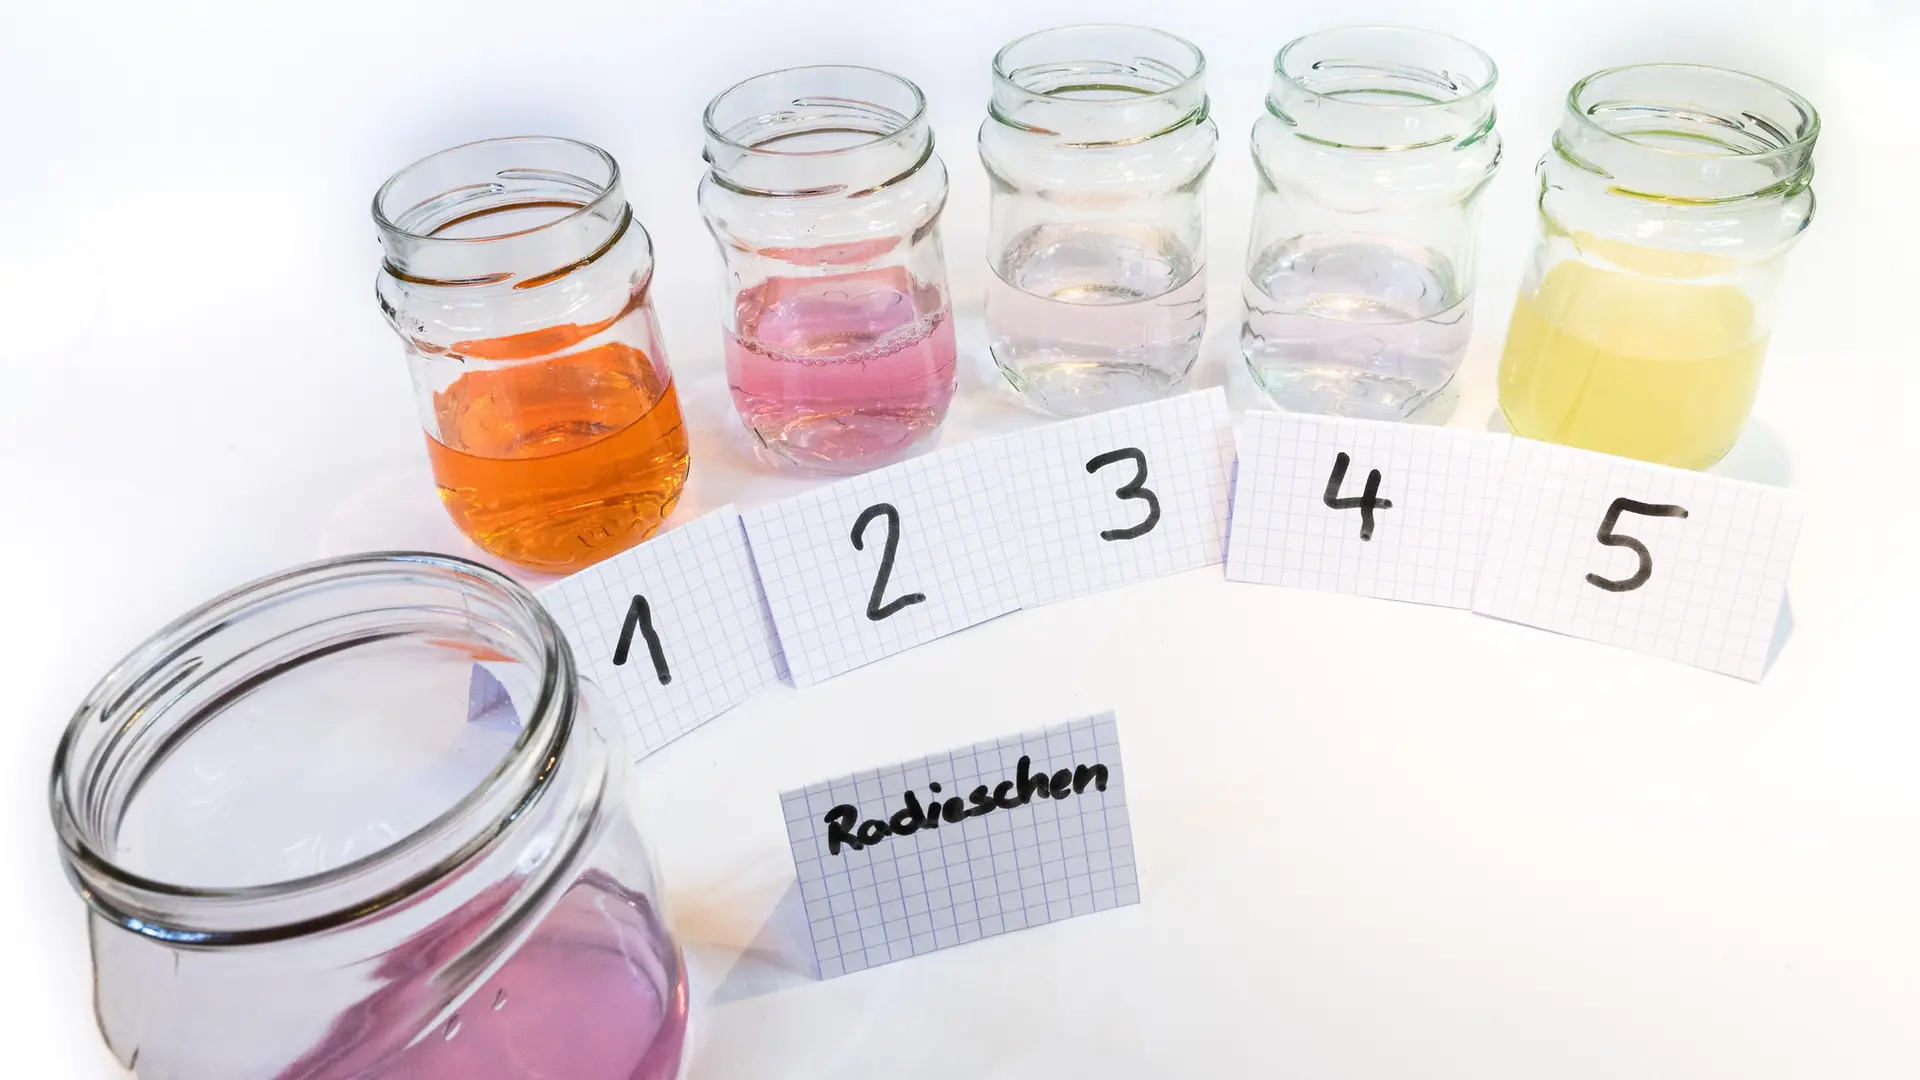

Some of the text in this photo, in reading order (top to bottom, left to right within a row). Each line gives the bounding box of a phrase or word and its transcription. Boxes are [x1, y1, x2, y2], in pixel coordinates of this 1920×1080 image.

[1085, 447, 1160, 541] 3
[1323, 452, 1392, 540] 4
[850, 503, 926, 622] 2
[1587, 497, 1689, 592] 5
[612, 594, 672, 686] 1
[824, 755, 1109, 856] Radieschen
